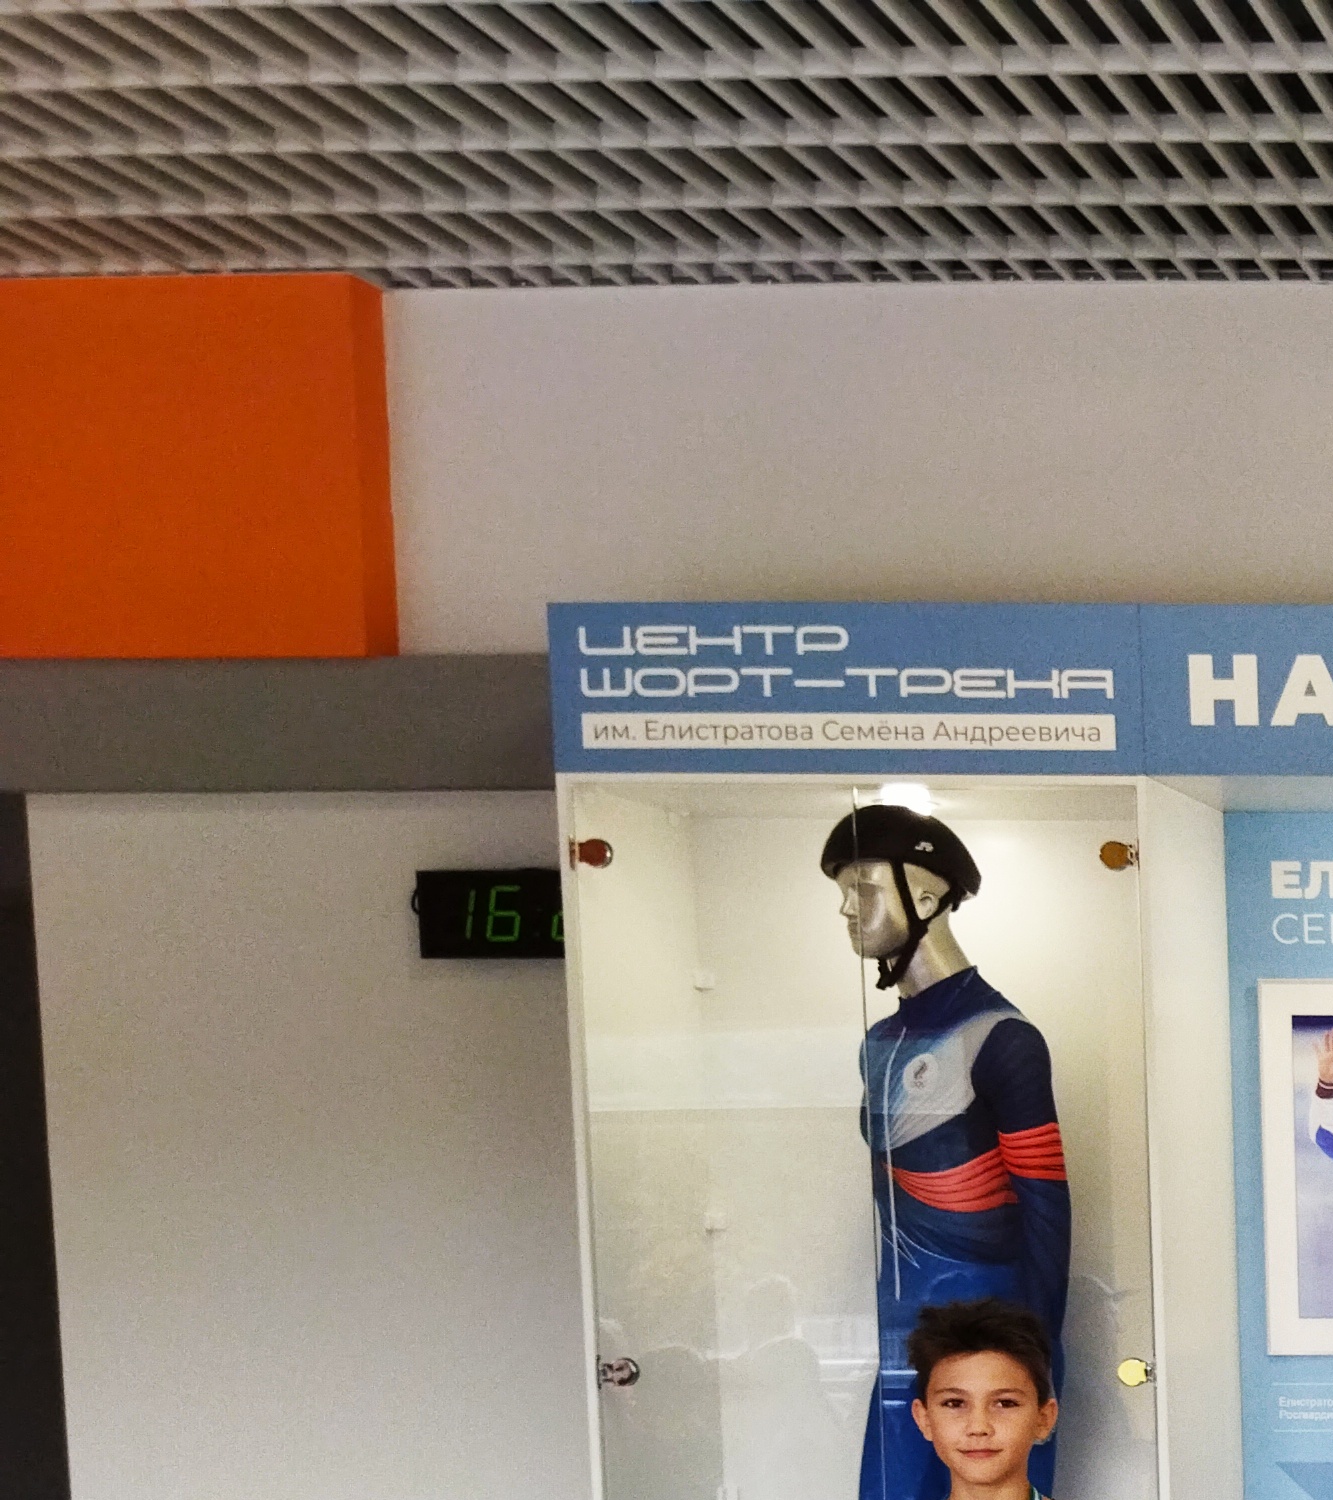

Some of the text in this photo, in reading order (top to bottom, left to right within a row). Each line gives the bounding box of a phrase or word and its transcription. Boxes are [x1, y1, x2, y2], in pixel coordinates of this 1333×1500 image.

[577, 625, 849, 656] ЦЕНТР
[593, 719, 1101, 747] им. Елистратова Семёна Андреевича
